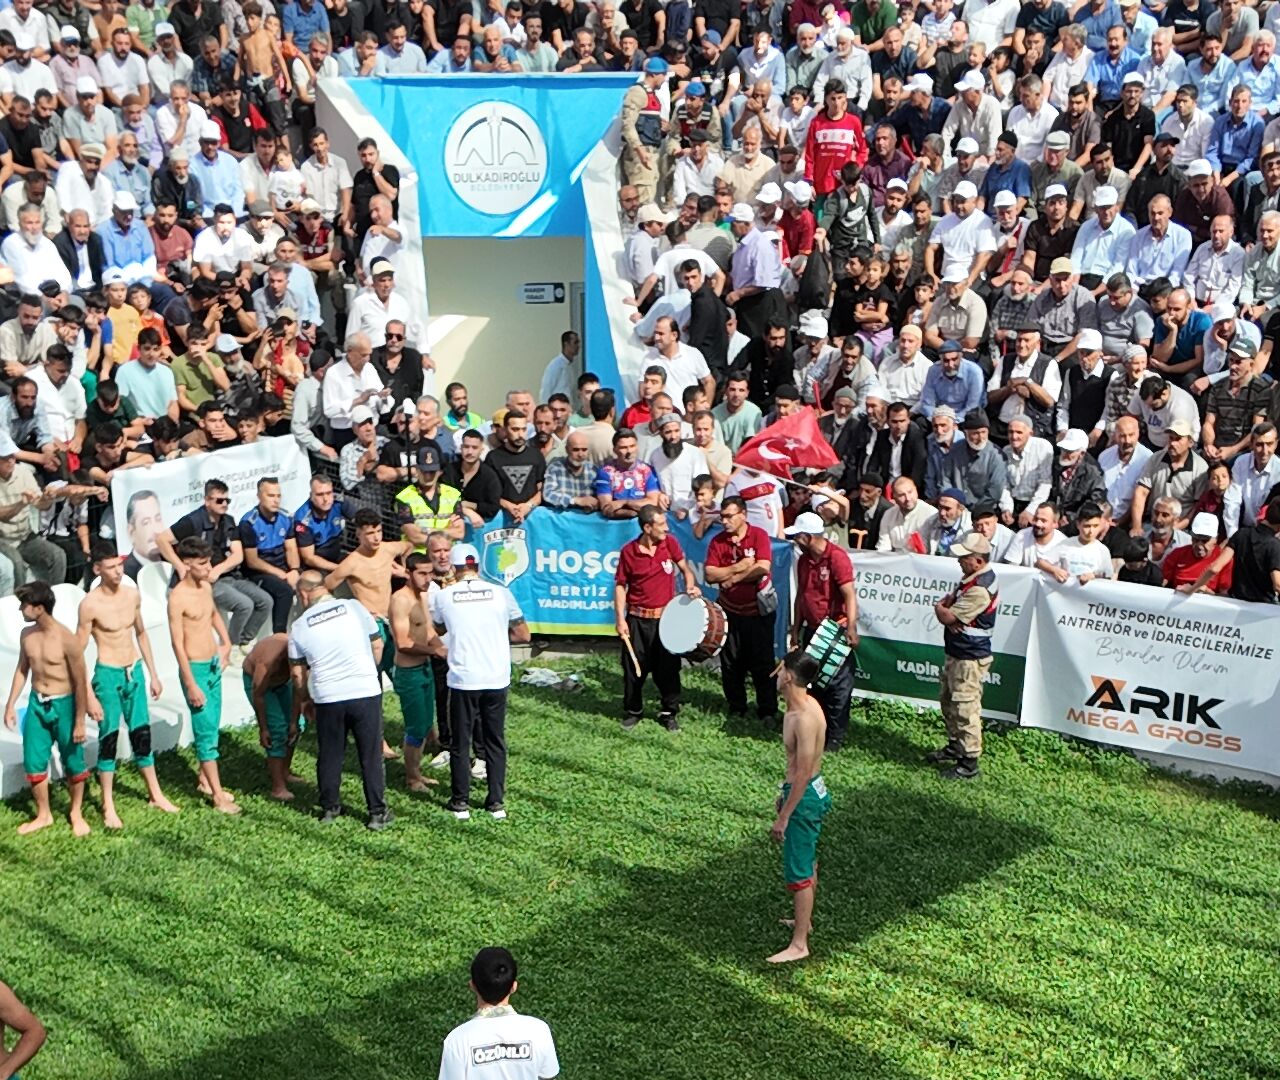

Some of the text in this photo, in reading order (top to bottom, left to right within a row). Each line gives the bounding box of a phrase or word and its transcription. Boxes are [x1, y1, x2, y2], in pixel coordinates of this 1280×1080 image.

[881, 593, 895, 603] ve
[1057, 615, 1274, 660] ANTRENÖR ve İDARECİLERİMİZE
[1088, 602, 1245, 642] TÜM SPORCULARIMIZA,
[897, 660, 939, 676] KADİR
[1085, 677, 1225, 730] ARIK
[1066, 707, 1242, 753] MEGA GROSS
